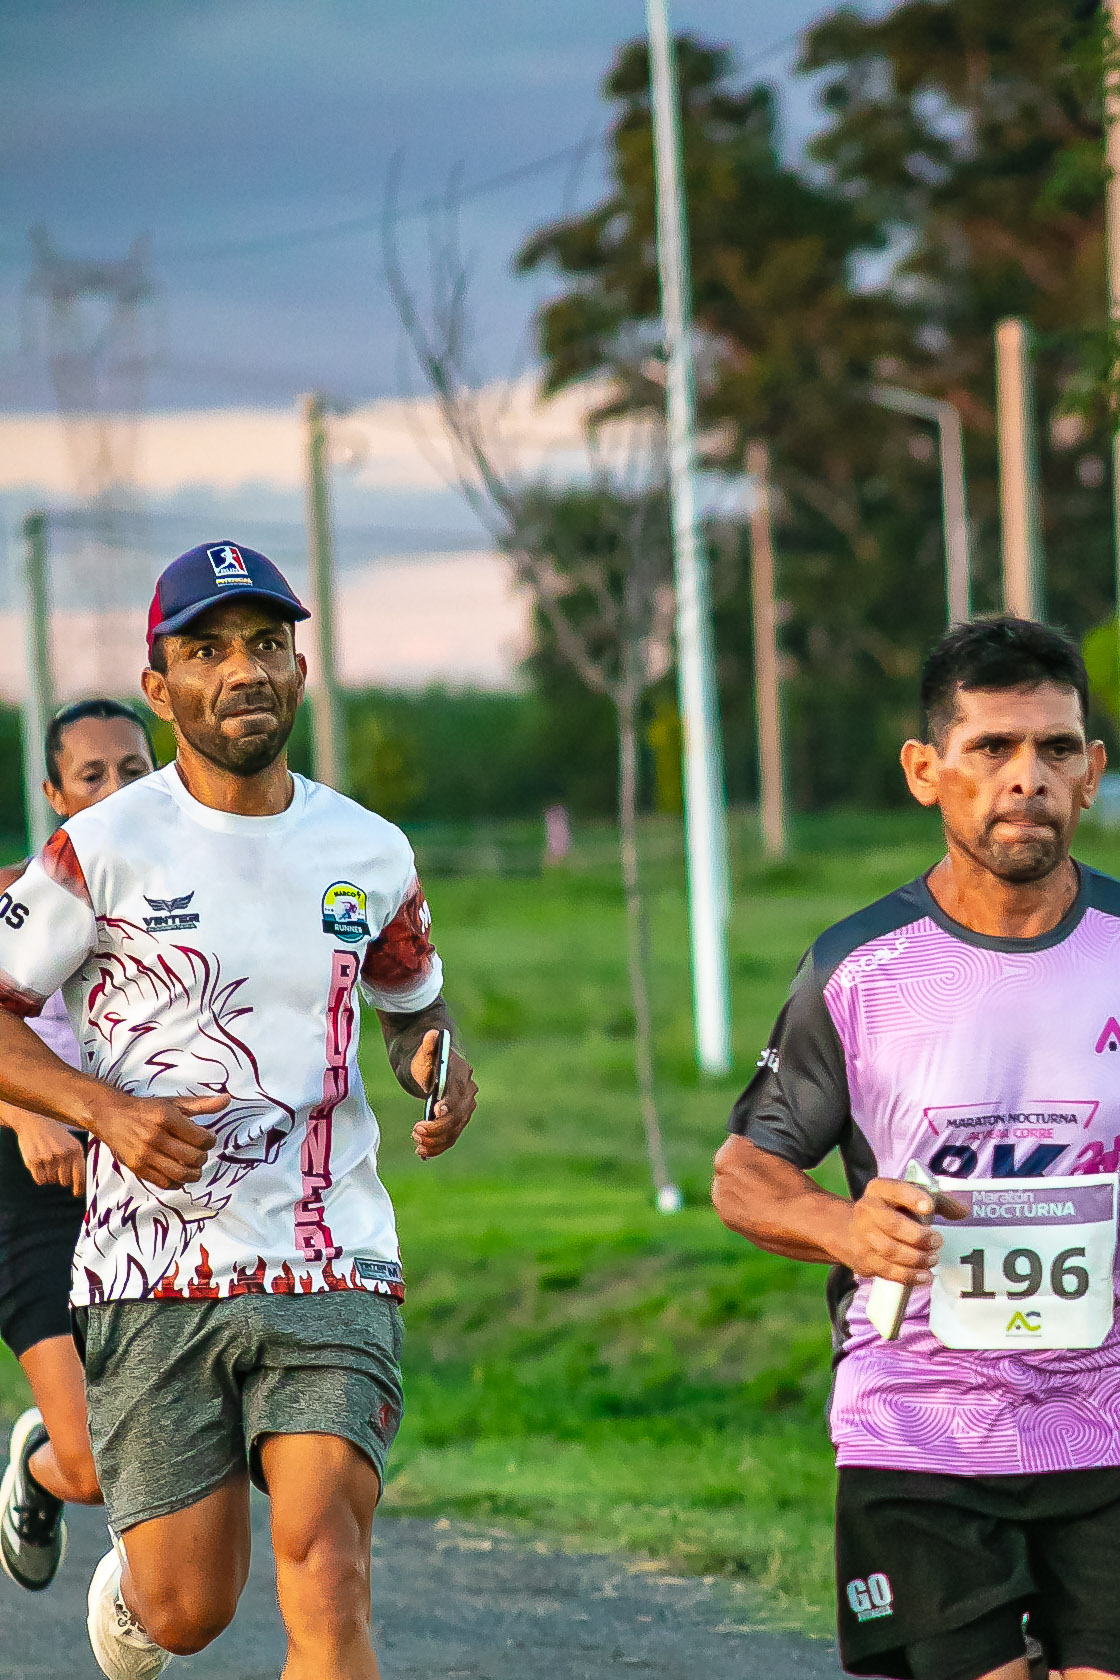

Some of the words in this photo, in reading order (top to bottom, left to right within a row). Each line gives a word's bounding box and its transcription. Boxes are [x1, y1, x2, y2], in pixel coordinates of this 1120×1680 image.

[142, 913, 200, 926] VINTER
[1007, 1113, 1079, 1125] NOCTURNA
[972, 1200, 1076, 1219] NOCTURNA
[960, 1247, 1090, 1300] 196
[847, 1573, 893, 1612] GO
